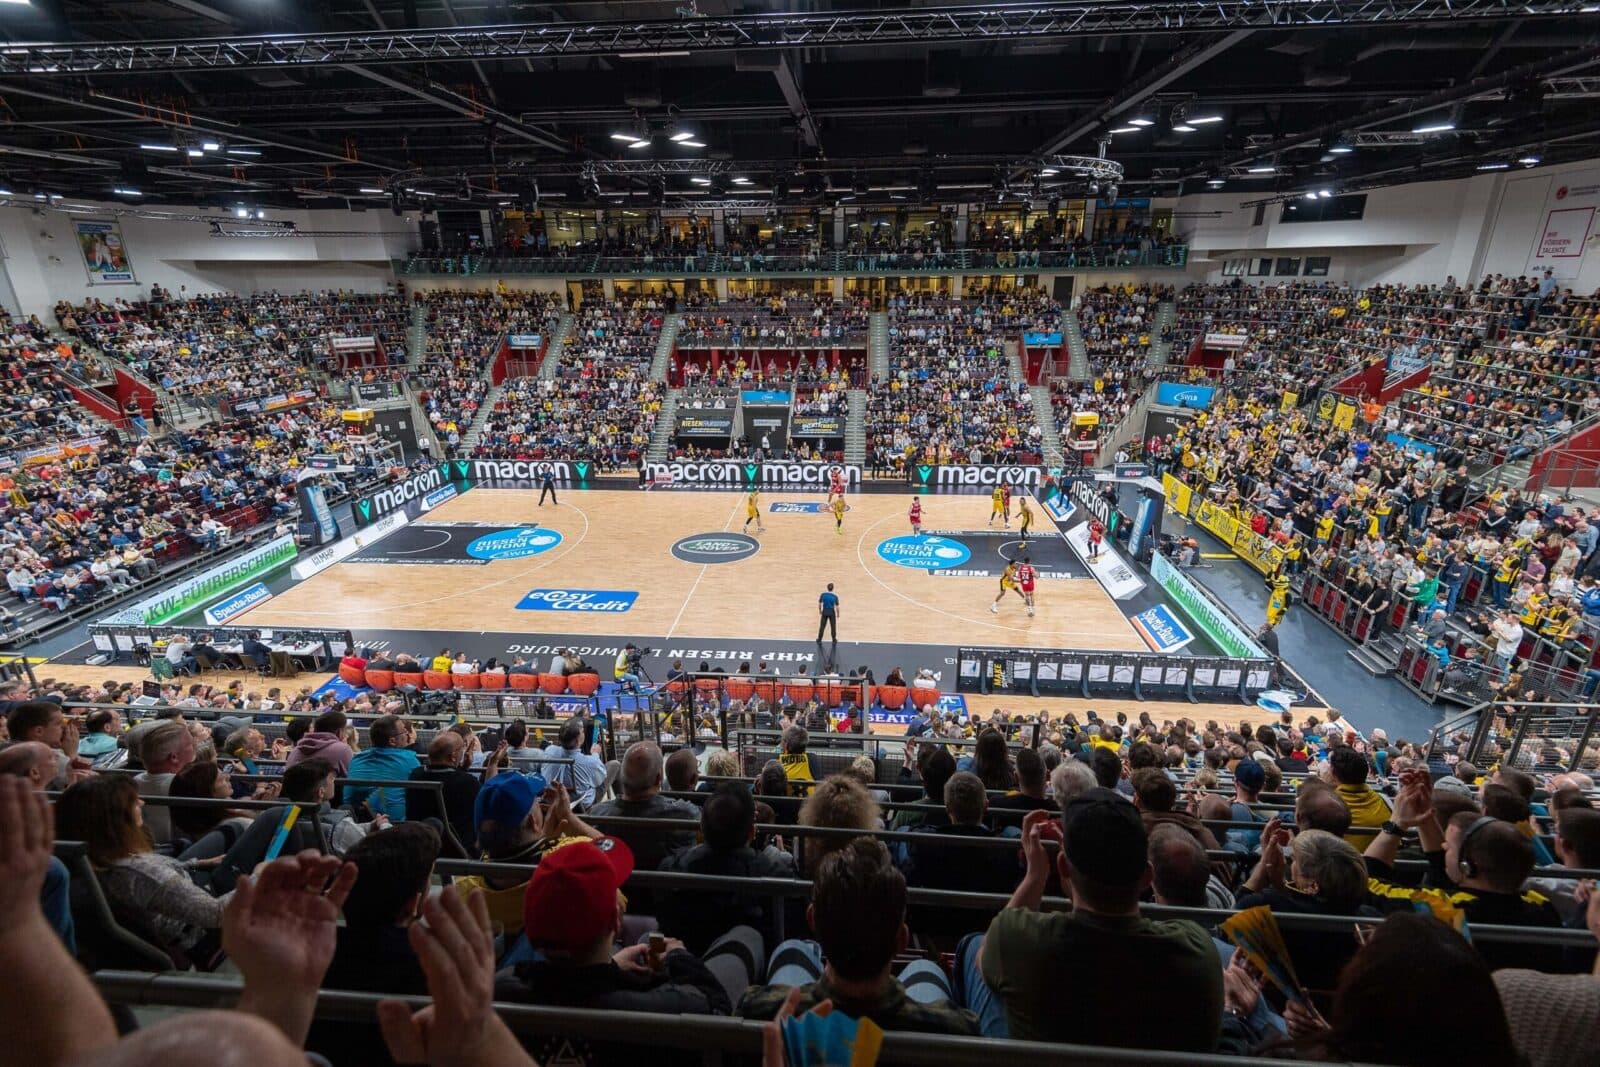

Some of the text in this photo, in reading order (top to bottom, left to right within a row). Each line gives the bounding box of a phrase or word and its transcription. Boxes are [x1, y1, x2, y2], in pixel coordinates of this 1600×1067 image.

[347, 425, 361, 436] 24
[474, 461, 571, 479] macron
[645, 463, 741, 482] macron
[762, 464, 861, 483] macron
[937, 466, 1041, 485] macron
[374, 469, 441, 515] macron
[474, 542, 527, 552] STROM
[475, 536, 529, 547] RIESEN
[885, 542, 934, 552] RIESEN
[881, 548, 933, 557] STROM
[934, 569, 989, 577] EHEIM
[214, 587, 268, 619] Sparda-Bank
[552, 600, 630, 611] Credit
[1143, 608, 1179, 645] Sparda-Bank
[667, 649, 753, 660] RIESEN
[761, 652, 815, 661] MHP
